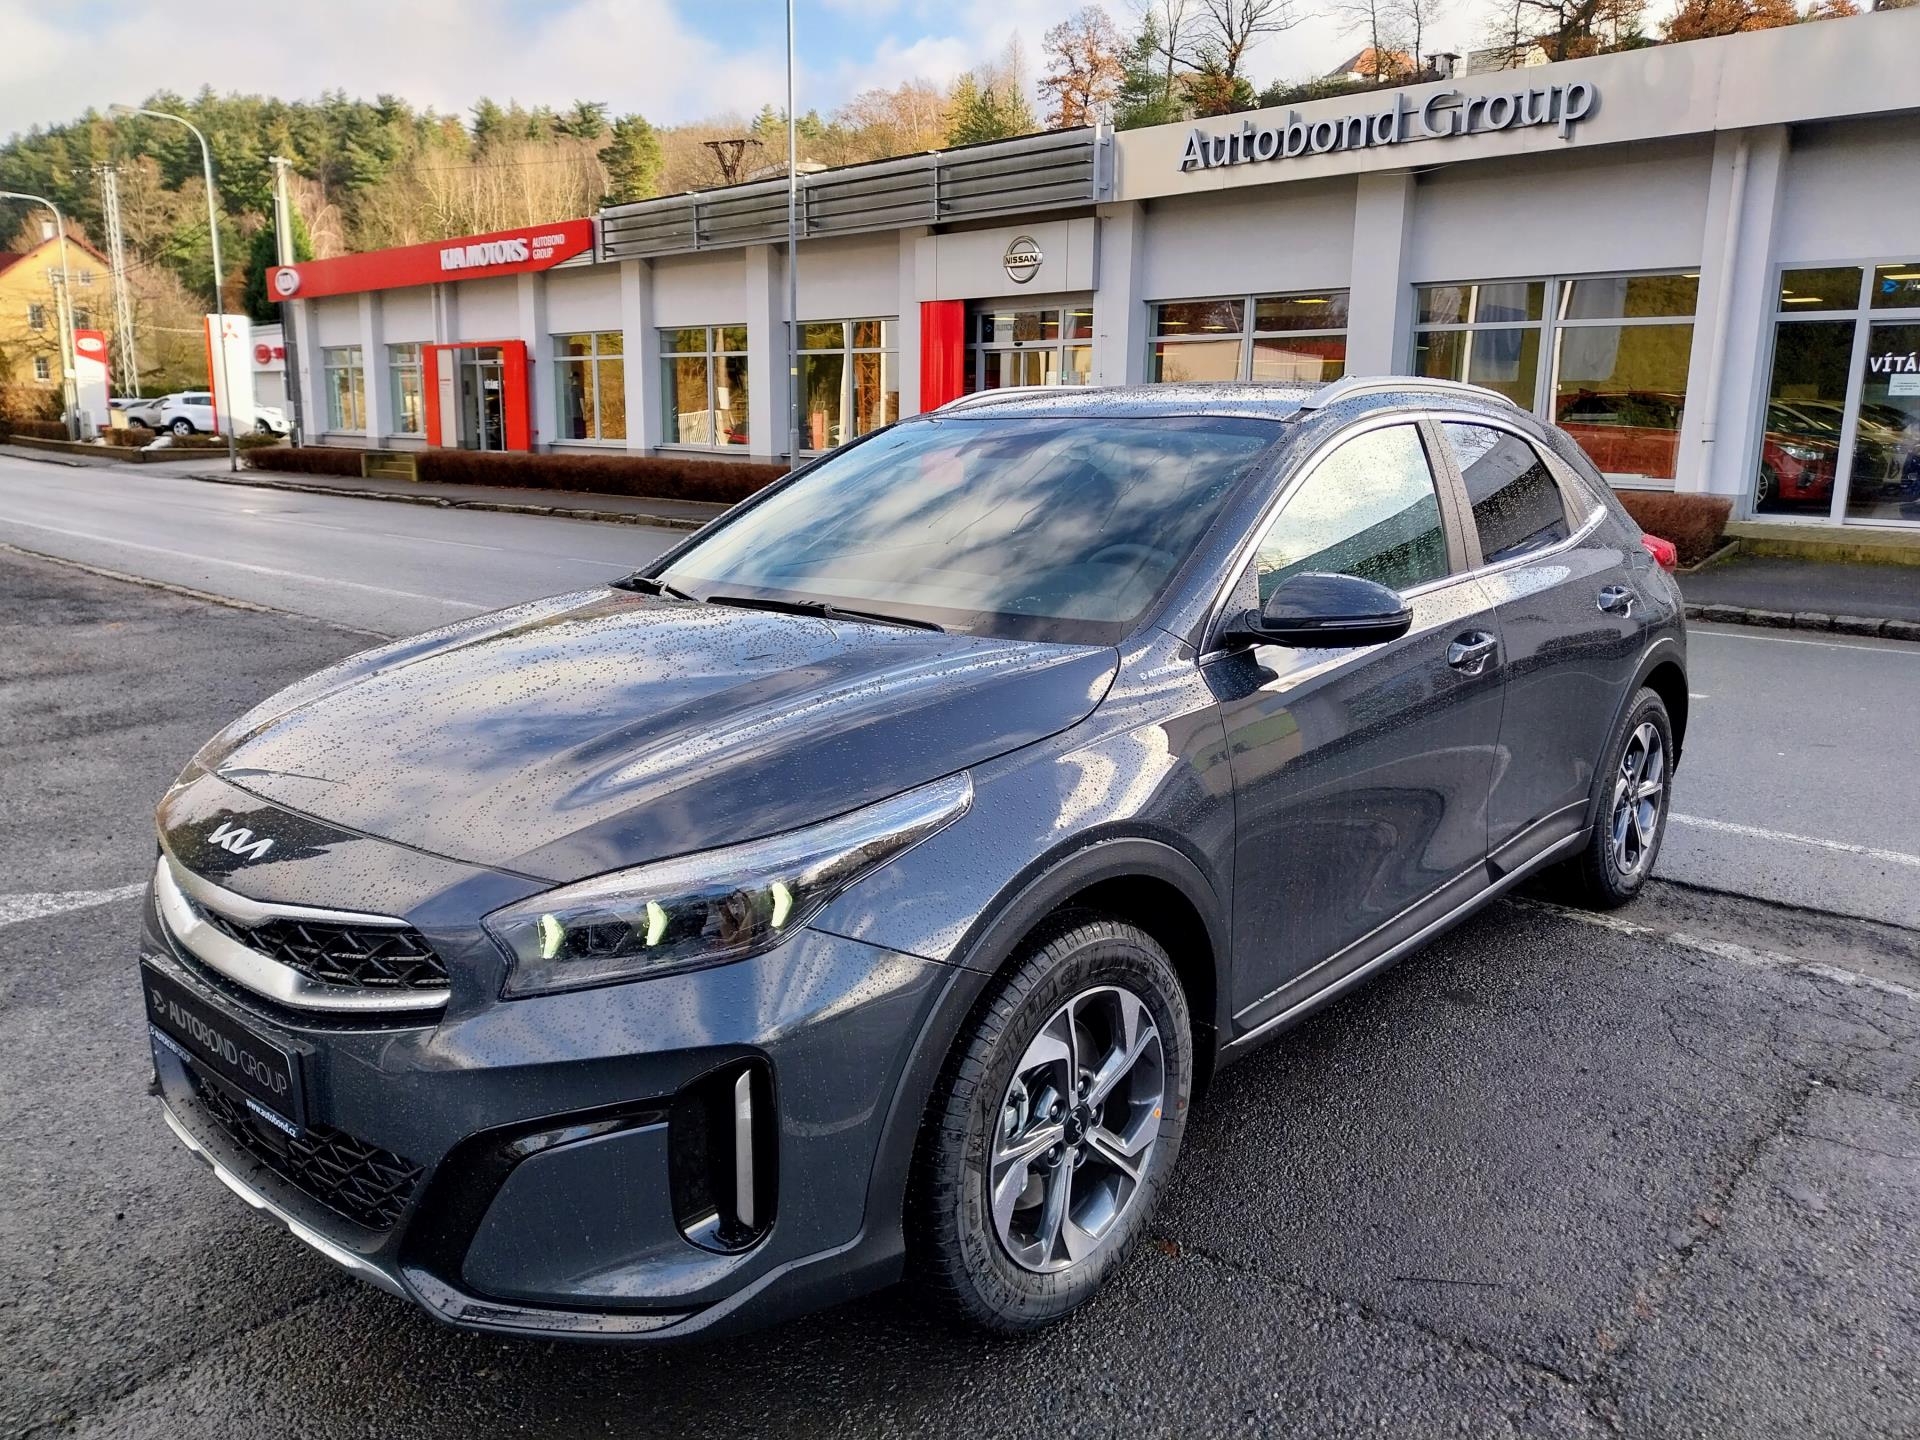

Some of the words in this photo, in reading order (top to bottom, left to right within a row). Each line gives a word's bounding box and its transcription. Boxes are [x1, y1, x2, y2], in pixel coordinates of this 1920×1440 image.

[1176, 93, 1405, 172] Autobond
[1418, 79, 1597, 141] Group
[466, 238, 529, 267] MOTORS
[532, 234, 565, 248] AUTOBOND
[532, 247, 554, 260] GROUP
[1005, 254, 1038, 264] NISSAN
[1870, 352, 1920, 373] VÍTÁ
[207, 821, 275, 861] KIA
[169, 1000, 238, 1065] AUTOBOND
[240, 1050, 287, 1097] GROUP
[245, 1098, 297, 1139] www.autobond.cz
